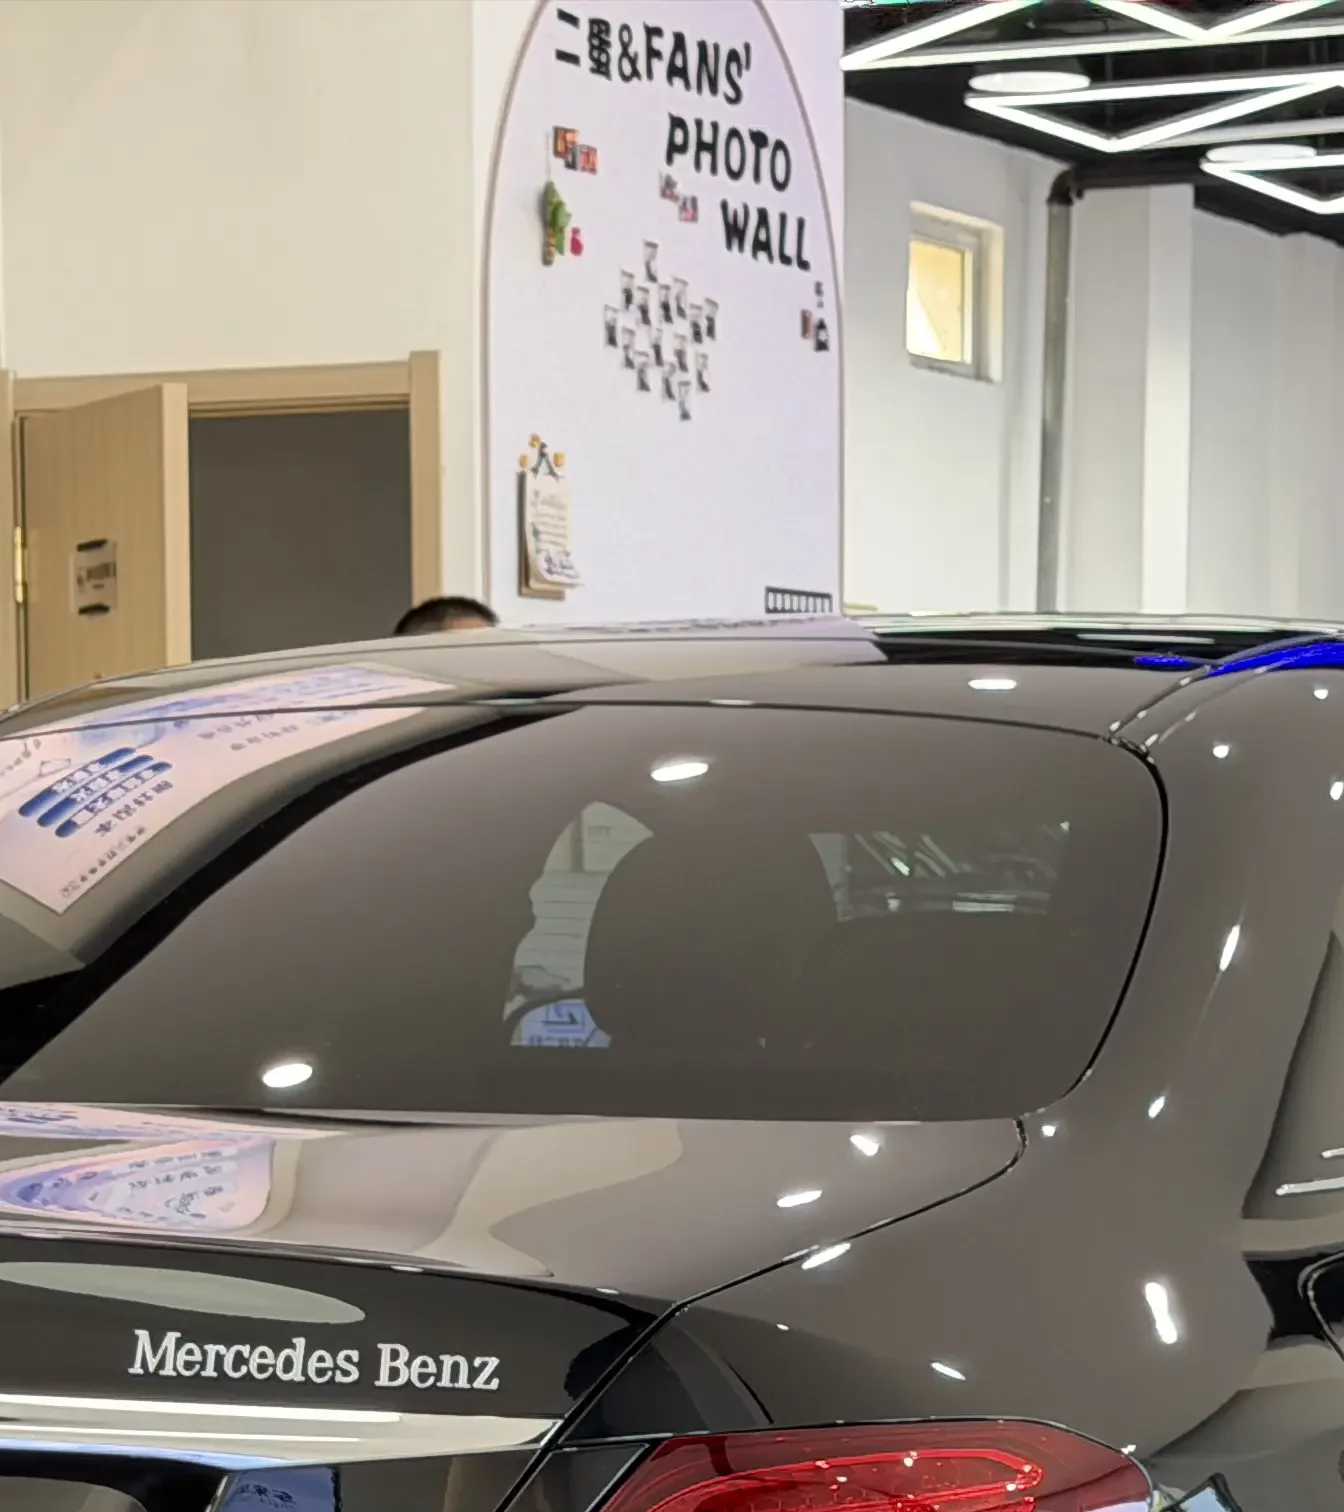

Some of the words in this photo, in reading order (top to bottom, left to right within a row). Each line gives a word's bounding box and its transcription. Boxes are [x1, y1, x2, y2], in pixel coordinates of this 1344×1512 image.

[665, 112, 792, 192] PHOTO
[719, 198, 811, 272] WALL
[127, 1328, 360, 1384] Mercedes
[373, 1342, 501, 1391] Benz
